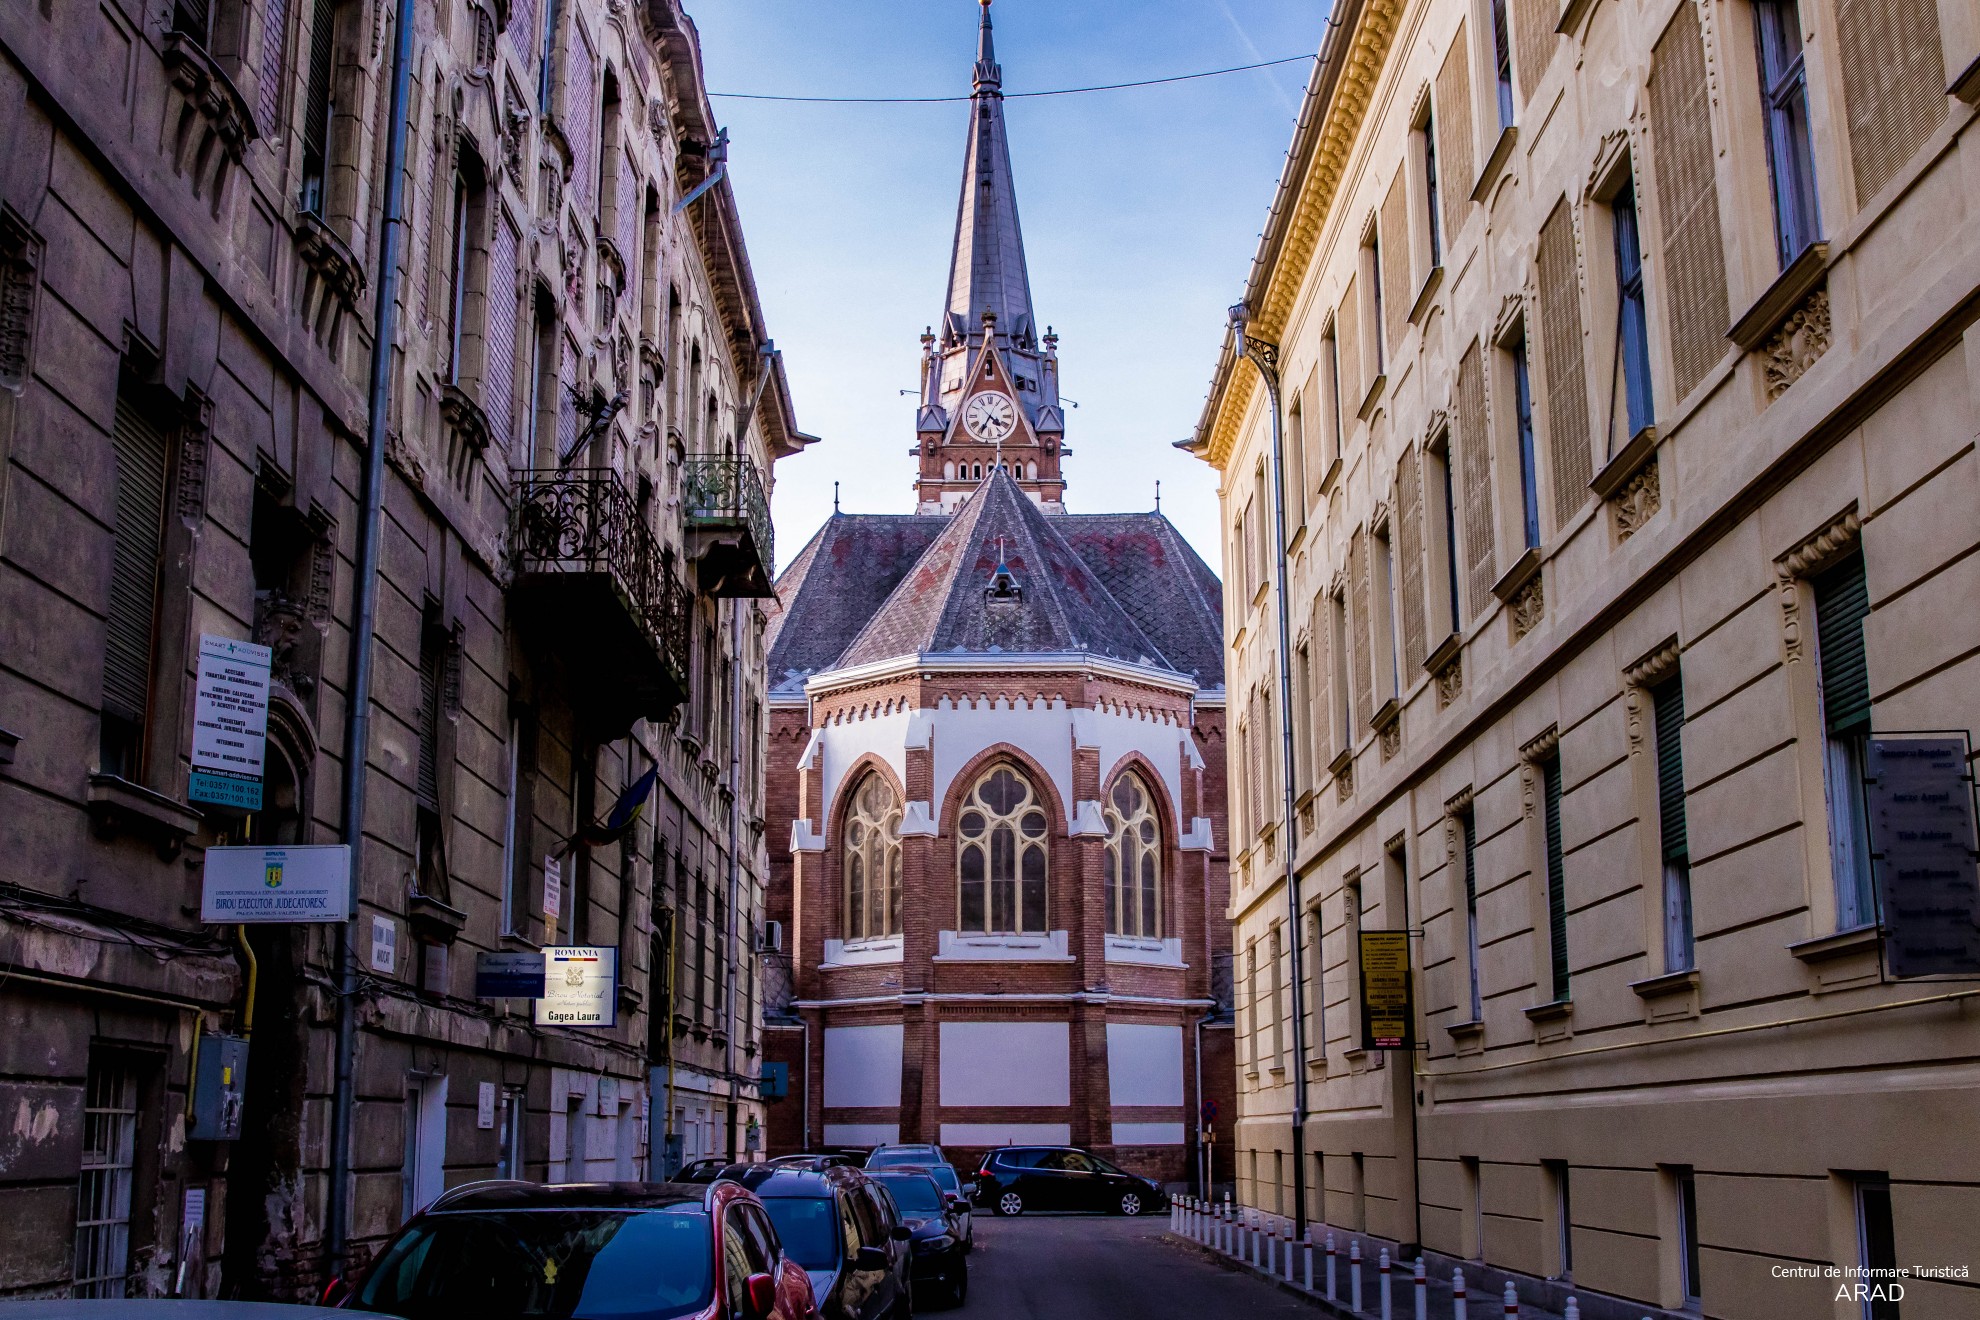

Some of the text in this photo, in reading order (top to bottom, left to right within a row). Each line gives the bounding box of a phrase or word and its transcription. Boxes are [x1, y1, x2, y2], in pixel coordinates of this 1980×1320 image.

[204, 640, 269, 658] SMART ADDVISER
[215, 897, 328, 910] BIROU EXECUTOR JUDECATORESC
[554, 949, 599, 957] ROMANIA
[547, 990, 568, 998] Birou
[548, 1010, 601, 1022] Gagea Laura
